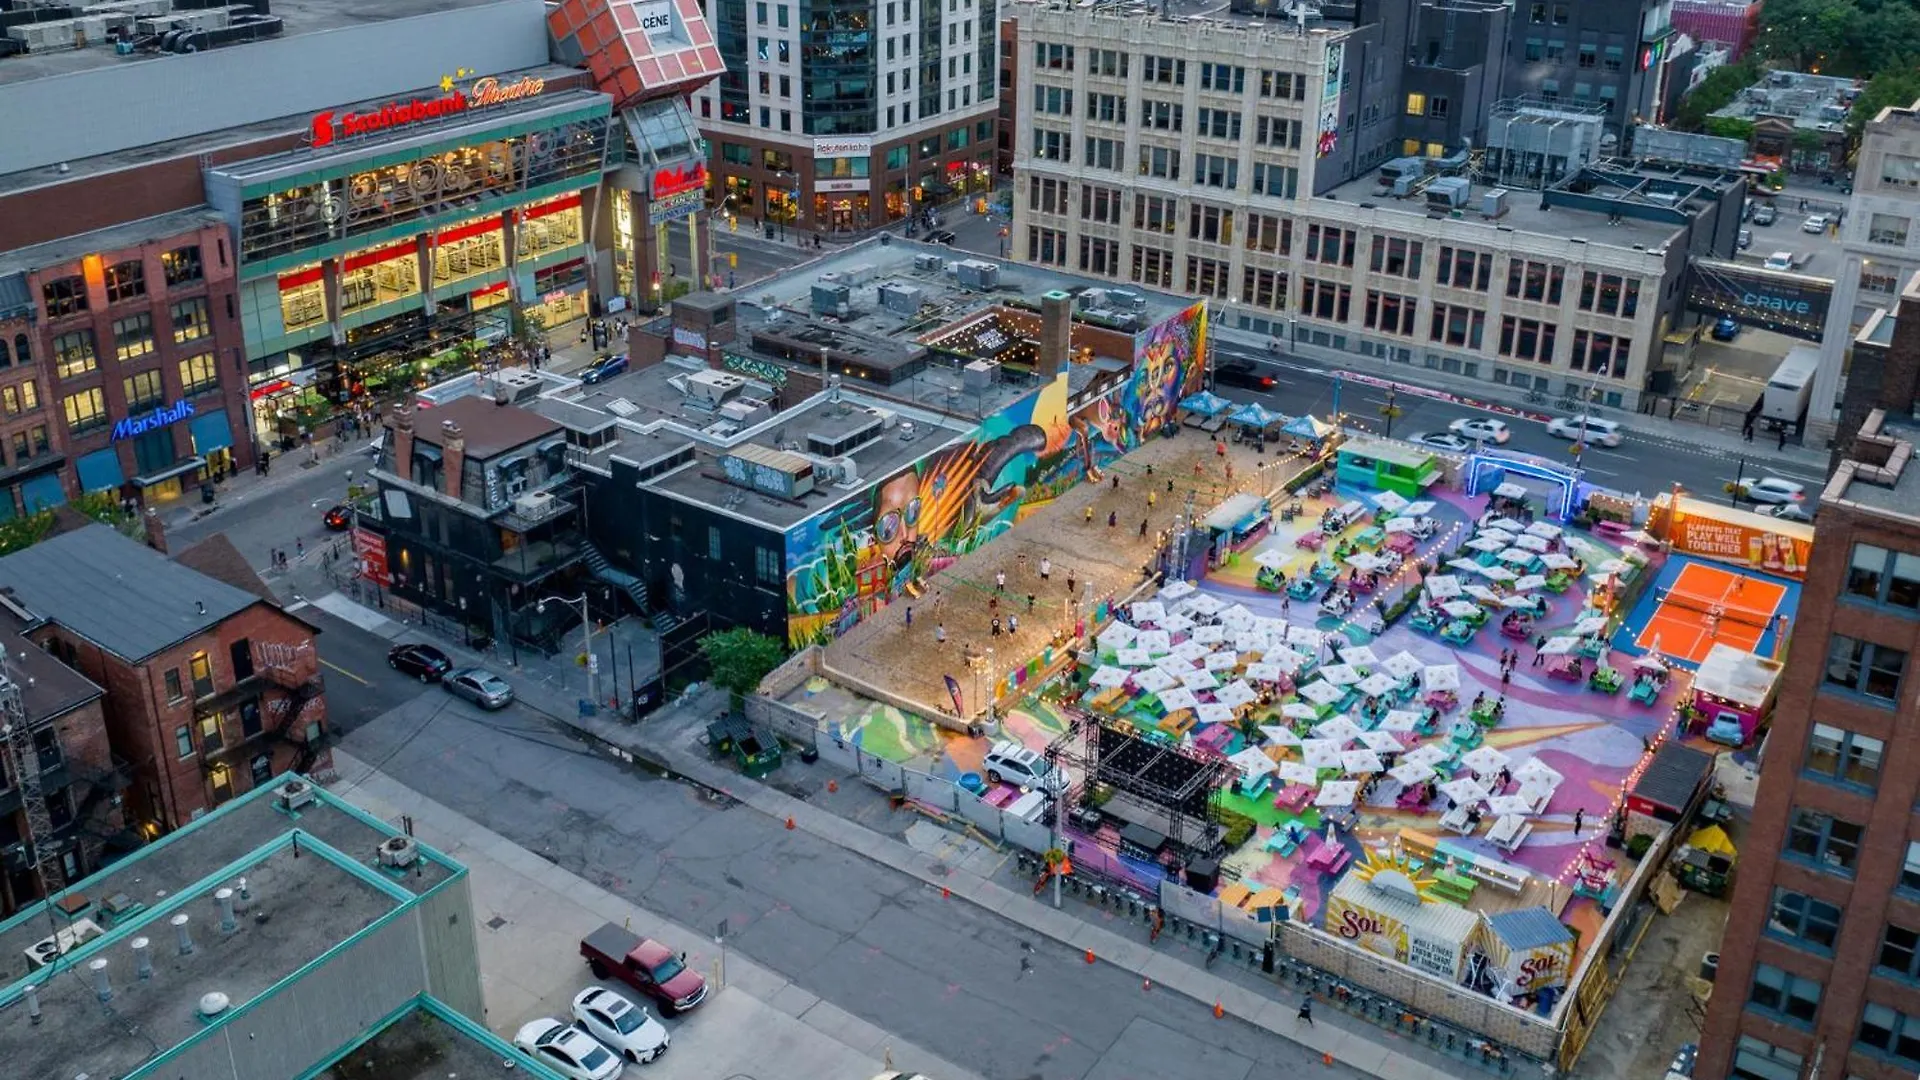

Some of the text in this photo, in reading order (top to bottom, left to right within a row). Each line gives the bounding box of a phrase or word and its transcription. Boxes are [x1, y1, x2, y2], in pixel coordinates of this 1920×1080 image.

[342, 90, 467, 135] Scotiabank
[111, 400, 194, 442] Marshalls
[1687, 530, 1742, 545] PLAY WELL
[1687, 540, 1741, 554] TOGETHER
